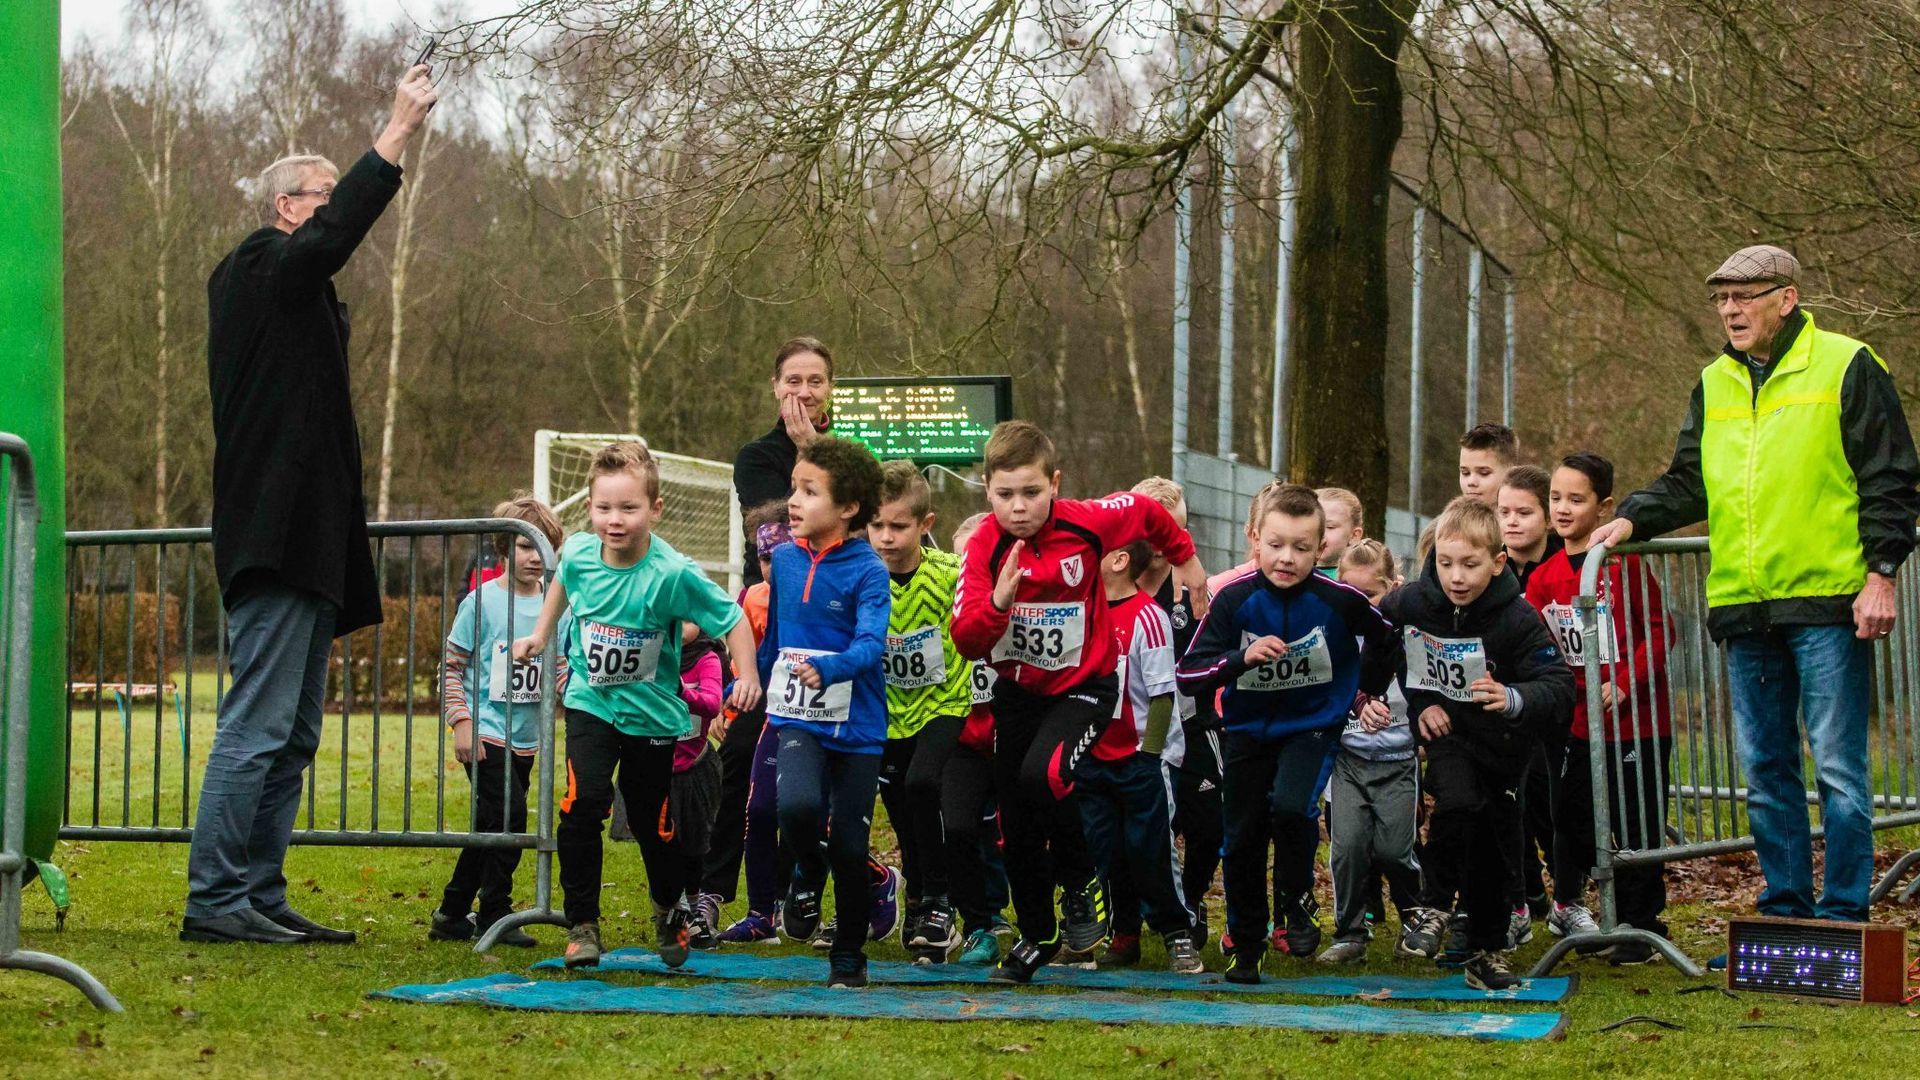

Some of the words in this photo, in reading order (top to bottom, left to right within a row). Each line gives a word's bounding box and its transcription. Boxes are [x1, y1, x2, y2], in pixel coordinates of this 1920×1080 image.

[590, 621, 658, 640] INTERSPORT
[1010, 615, 1066, 626] MEIJERS
[590, 632, 644, 648] MEIJERS
[885, 628, 935, 648] TERSPORT
[1012, 624, 1064, 658] 533
[1560, 626, 1583, 654] 50
[587, 643, 641, 676] 505
[1257, 657, 1312, 682] 504
[1426, 652, 1467, 690] 503
[512, 664, 542, 692] 50
[784, 673, 826, 709] 512
